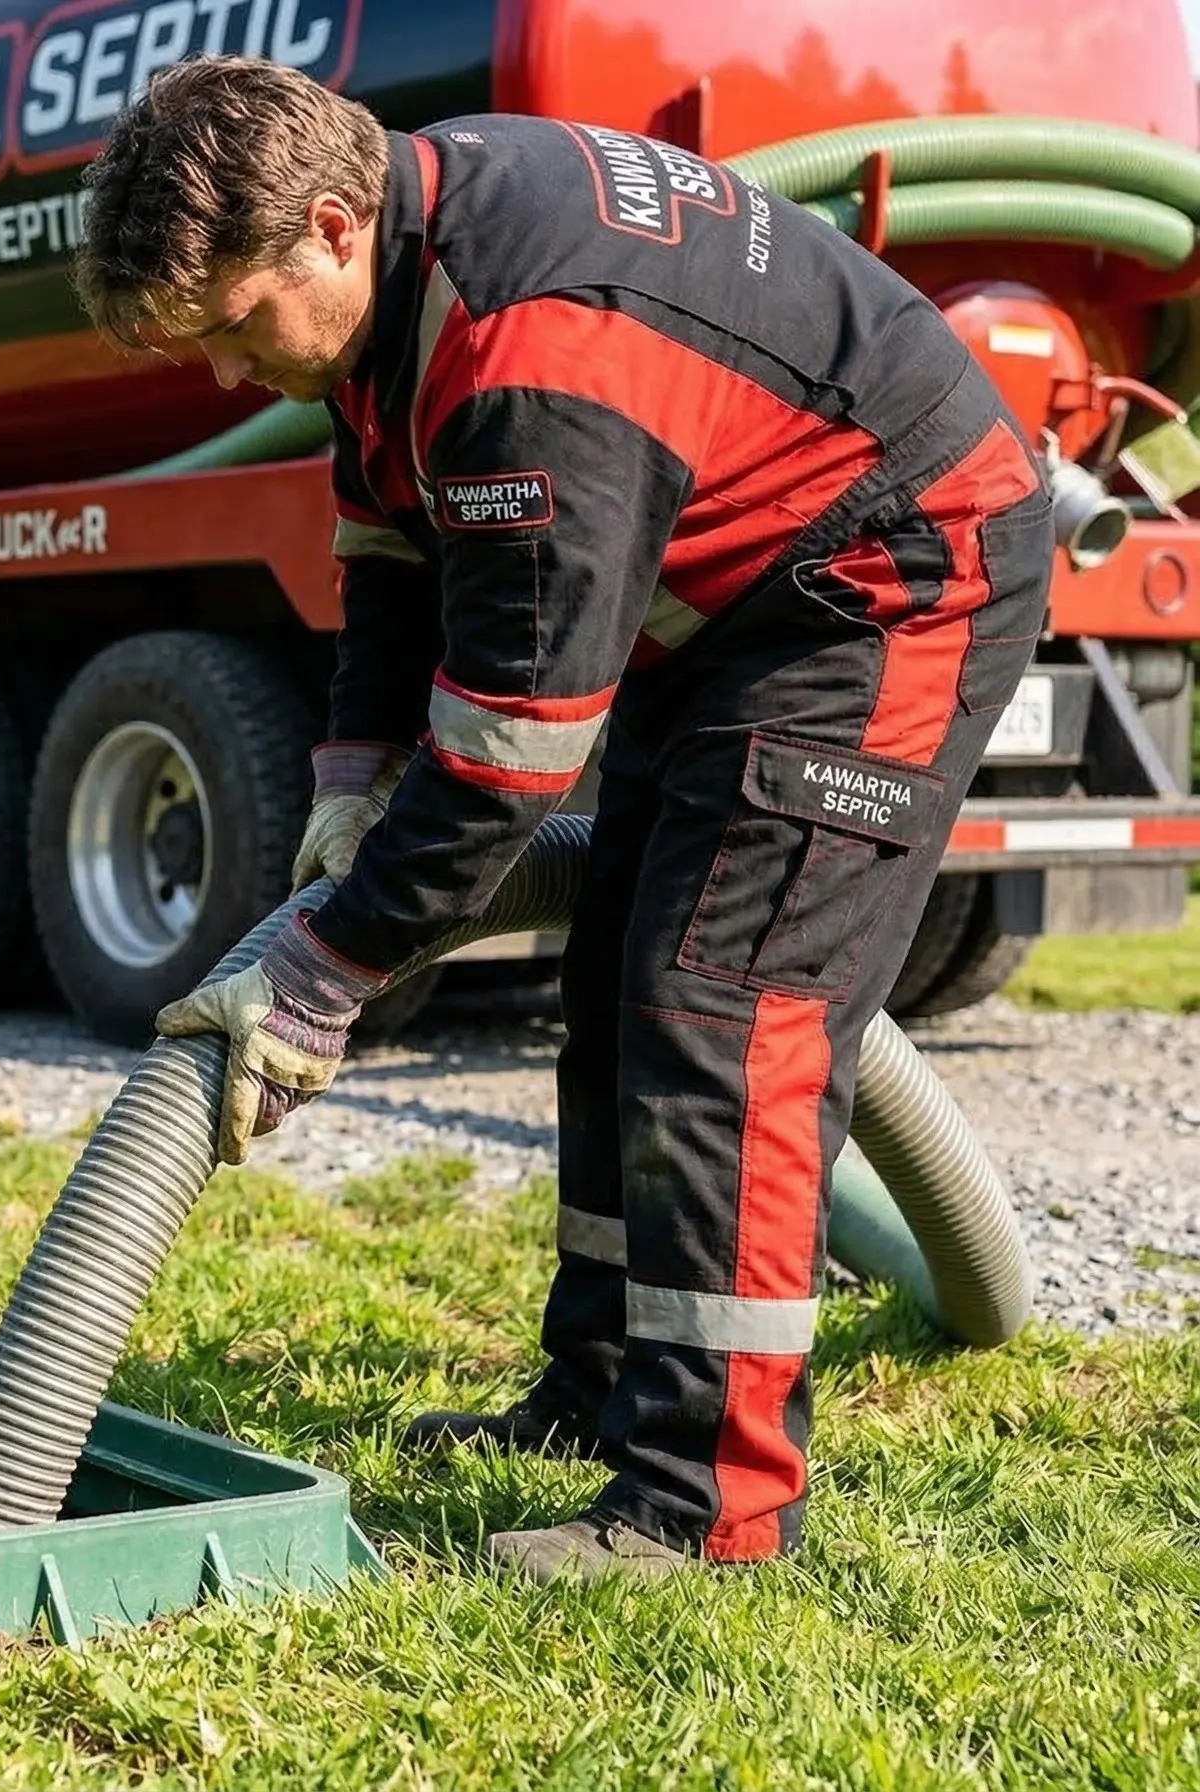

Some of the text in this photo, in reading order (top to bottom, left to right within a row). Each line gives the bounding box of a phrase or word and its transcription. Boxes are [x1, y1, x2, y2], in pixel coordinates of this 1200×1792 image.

[22, 0, 333, 136] SEPTIC
[445, 480, 543, 503] KAWARTHA
[460, 501, 523, 521] SEPTIC
[802, 760, 913, 806] KAWARTHA
[821, 790, 892, 826] SEPTIC
